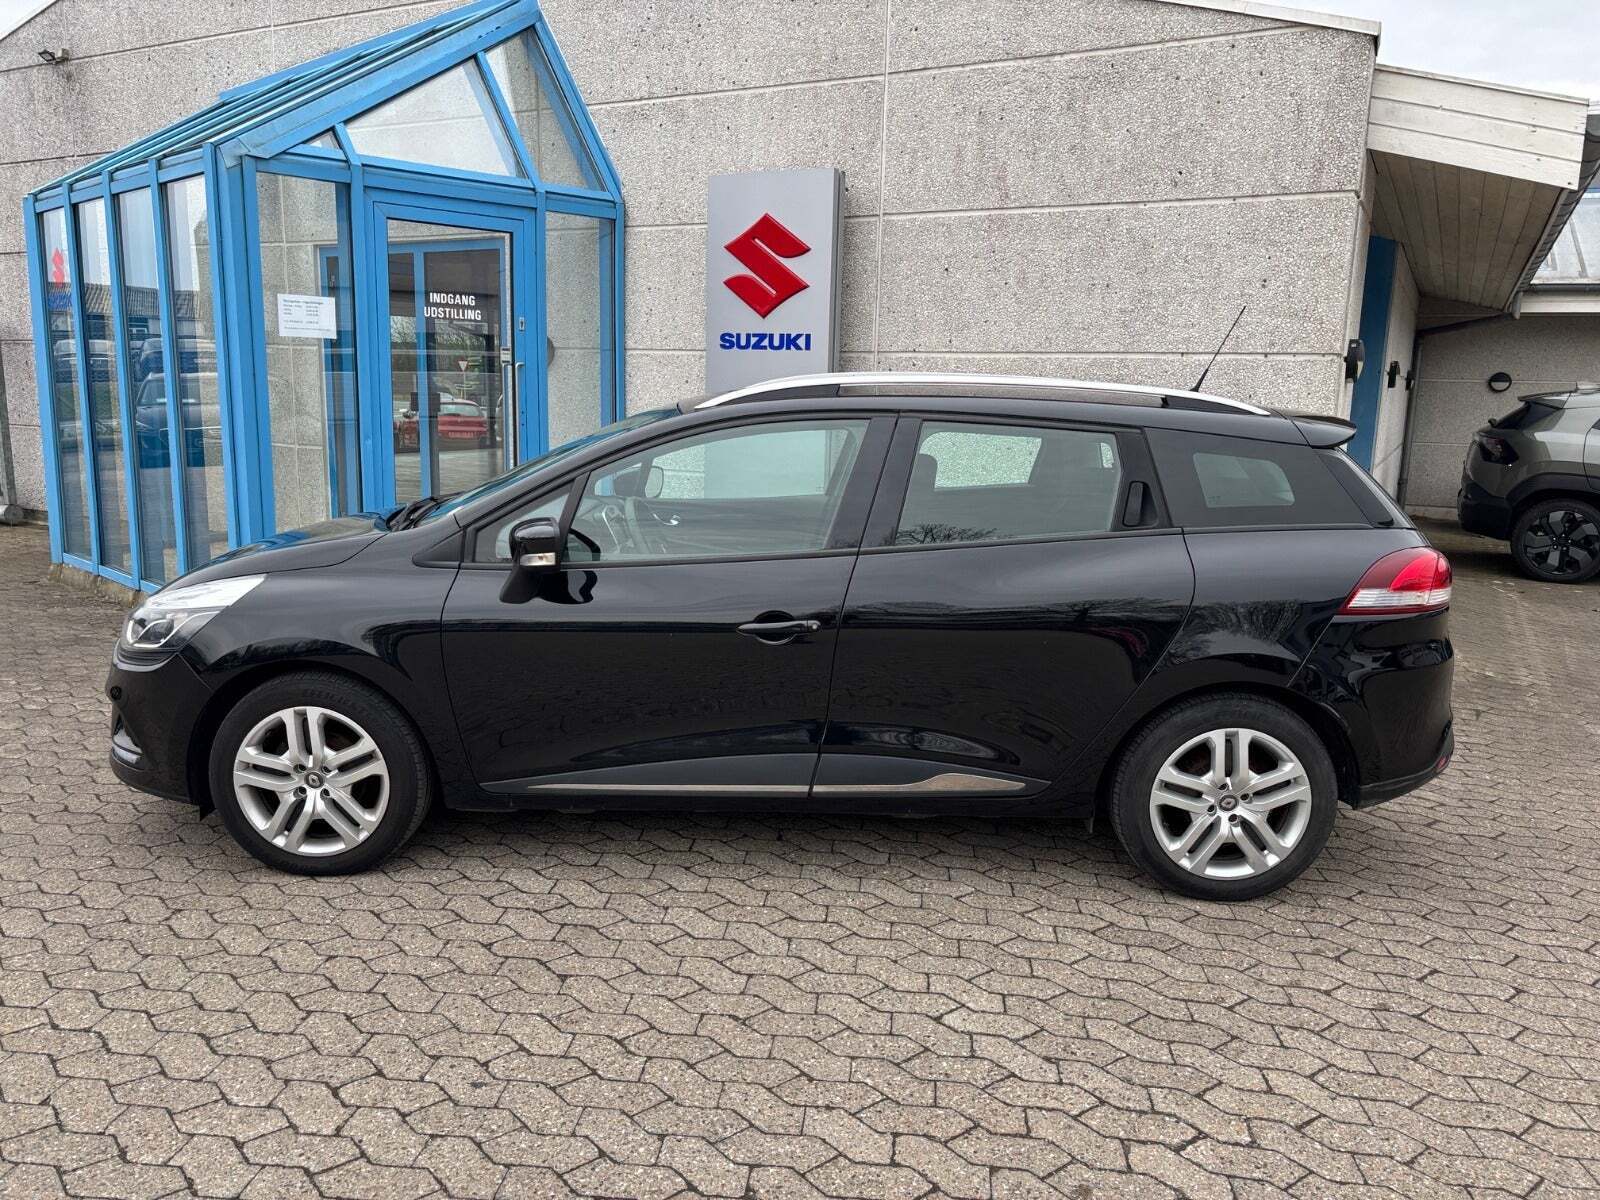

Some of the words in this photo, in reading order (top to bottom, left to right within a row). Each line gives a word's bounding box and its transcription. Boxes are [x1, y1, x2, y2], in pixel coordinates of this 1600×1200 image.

[430, 292, 476, 306] INDGANG
[423, 306, 482, 321] UDSTILLING
[719, 332, 812, 351] SUZUKI
